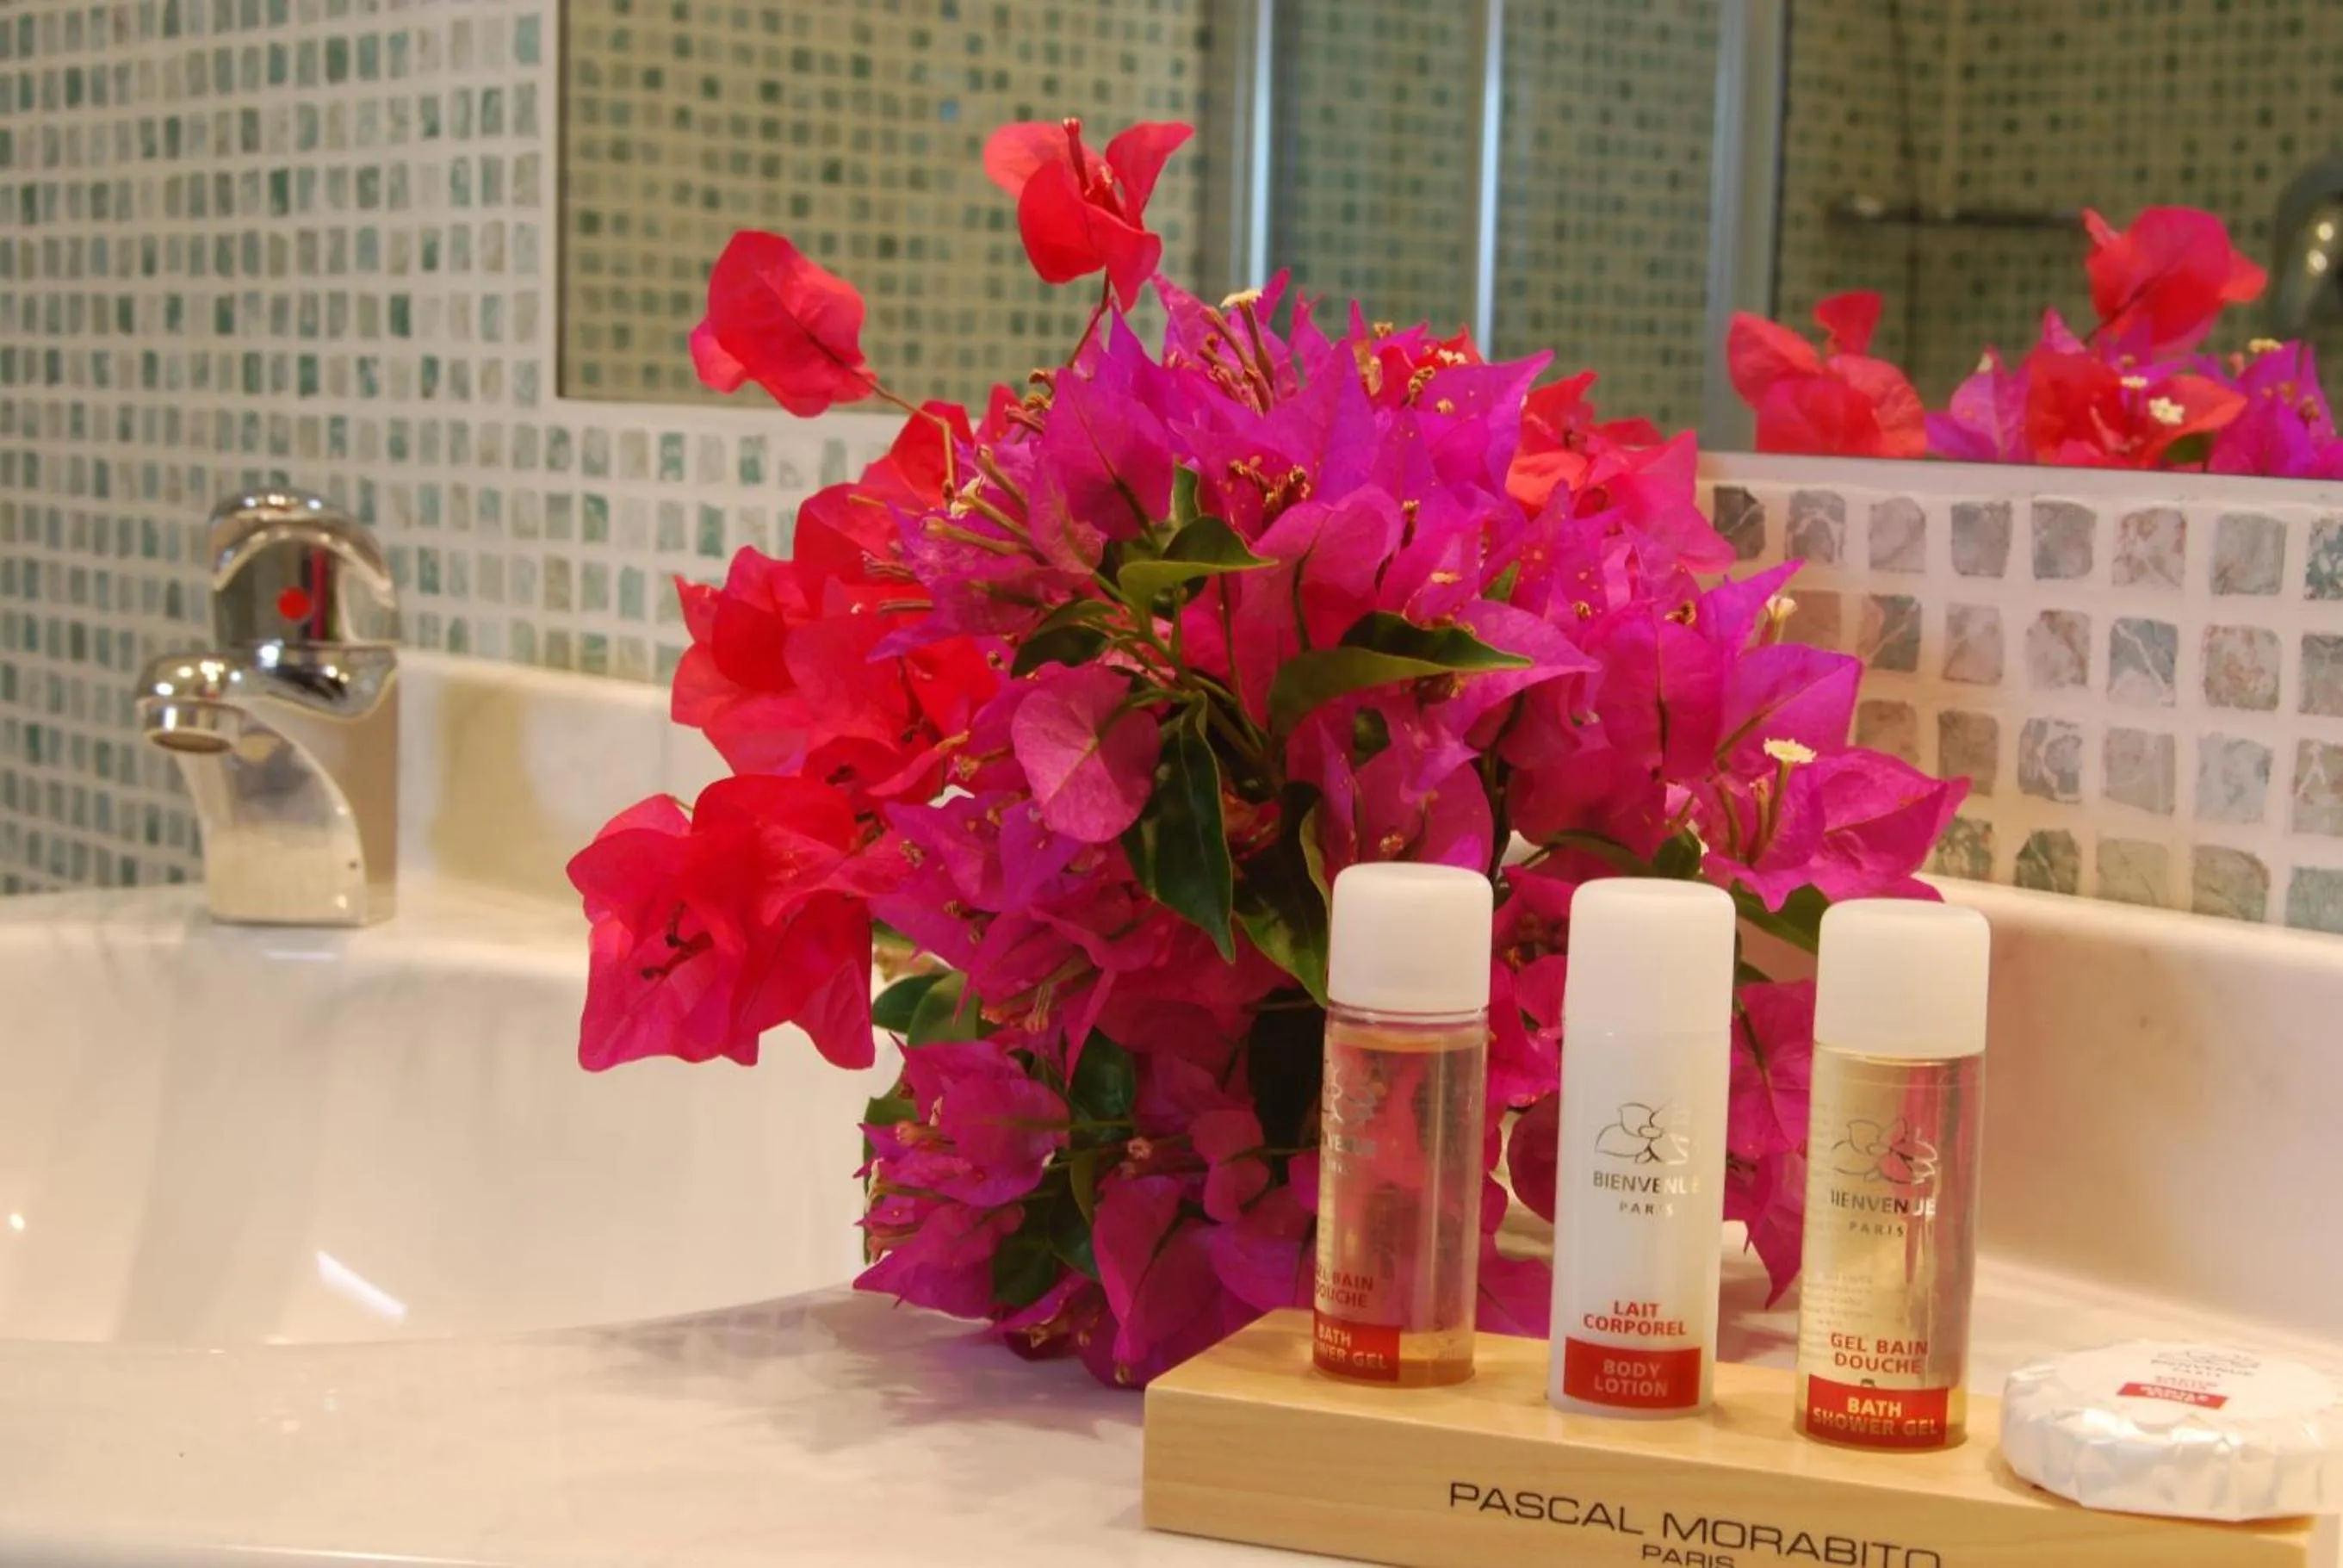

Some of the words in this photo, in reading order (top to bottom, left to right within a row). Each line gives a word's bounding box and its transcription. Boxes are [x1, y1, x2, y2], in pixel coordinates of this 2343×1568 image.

[1619, 1200, 1674, 1218] PARS
[1850, 1220, 1905, 1237] PARIS
[1333, 1271, 1374, 1292] BAIN
[1613, 1300, 1661, 1318] LAIT
[1318, 1323, 1352, 1348] BATH
[1583, 1313, 1687, 1336] CORPOREL
[1830, 1331, 1867, 1353] GEL
[1875, 1337, 1929, 1355] BAIN
[1352, 1350, 1388, 1370] GEL
[1602, 1358, 1662, 1379] BODY
[1834, 1350, 1924, 1375] DOUCHE
[1594, 1376, 1669, 1398] LOTION
[1847, 1396, 1903, 1419] BATH
[1812, 1406, 1895, 1437] SHOWER
[1902, 1416, 1938, 1436] GEL
[1449, 1481, 1645, 1536] PASCAL
[1663, 1511, 1942, 1568] MORABITO
[1642, 1544, 1735, 1568] PARIS
